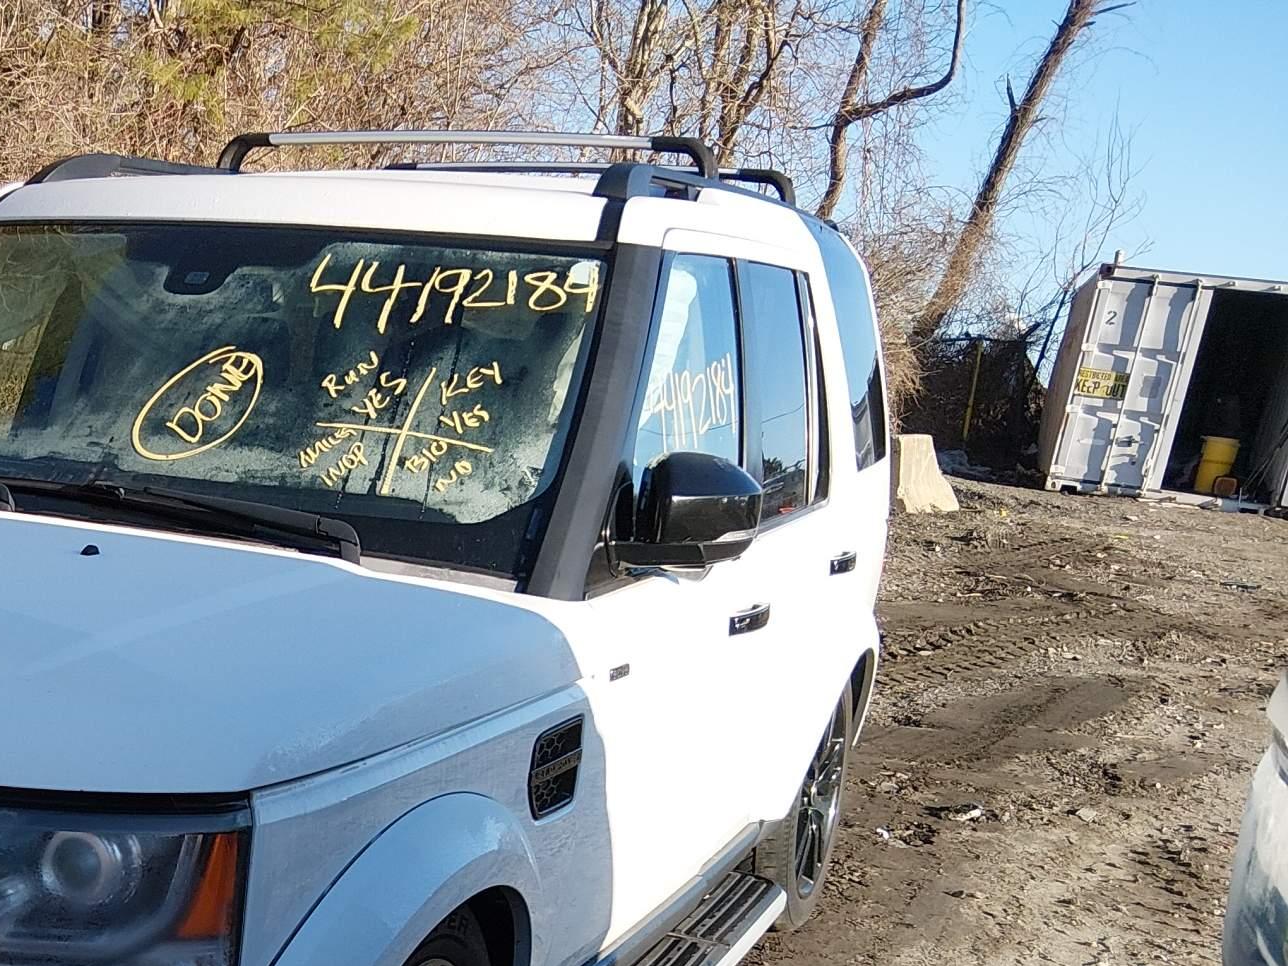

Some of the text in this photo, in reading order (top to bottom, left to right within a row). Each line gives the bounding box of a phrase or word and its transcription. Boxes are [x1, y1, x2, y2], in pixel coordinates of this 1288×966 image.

[1105, 310, 1117, 326] 2
[166, 354, 262, 444] DONE
[351, 371, 407, 419] YES
[440, 361, 503, 406] KEY
[439, 403, 490, 435] YES
[320, 441, 368, 488] INOP
[434, 459, 473, 493] NO
